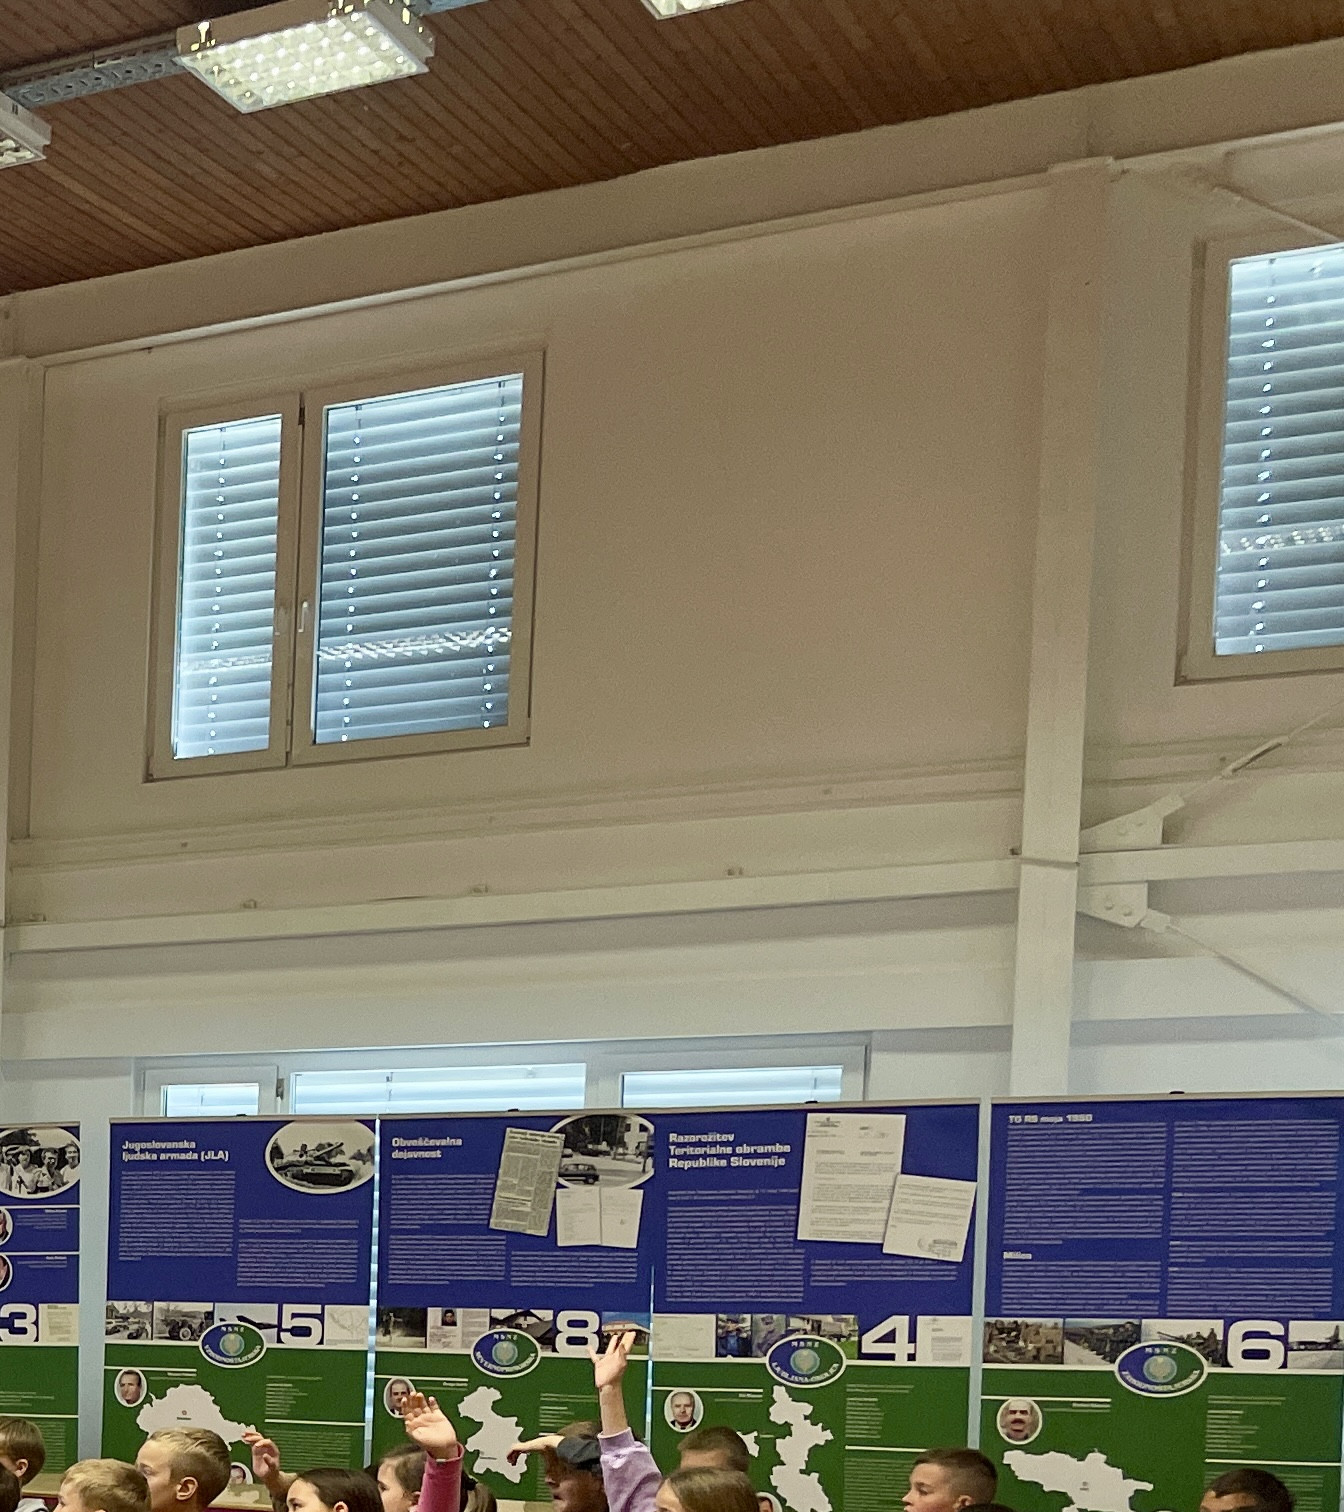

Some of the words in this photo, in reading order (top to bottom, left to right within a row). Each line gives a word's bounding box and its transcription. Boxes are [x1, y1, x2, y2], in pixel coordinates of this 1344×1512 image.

[122, 1140, 196, 1151] Jugoslovanska
[122, 1151, 158, 1162] ljudska
[159, 1151, 199, 1160] armada
[200, 1150, 229, 1162] (JLA)
[392, 1149, 442, 1159] dejavnost
[669, 1145, 732, 1156] Teritorialne
[735, 1143, 791, 1154] obrambe
[669, 1157, 727, 1170] Republike
[730, 1155, 786, 1168] Slovenije
[0, 1303, 37, 1343] 3
[280, 1304, 323, 1346] 5
[555, 1310, 600, 1355] 8
[861, 1315, 915, 1363] 4
[1227, 1320, 1285, 1371] 6
